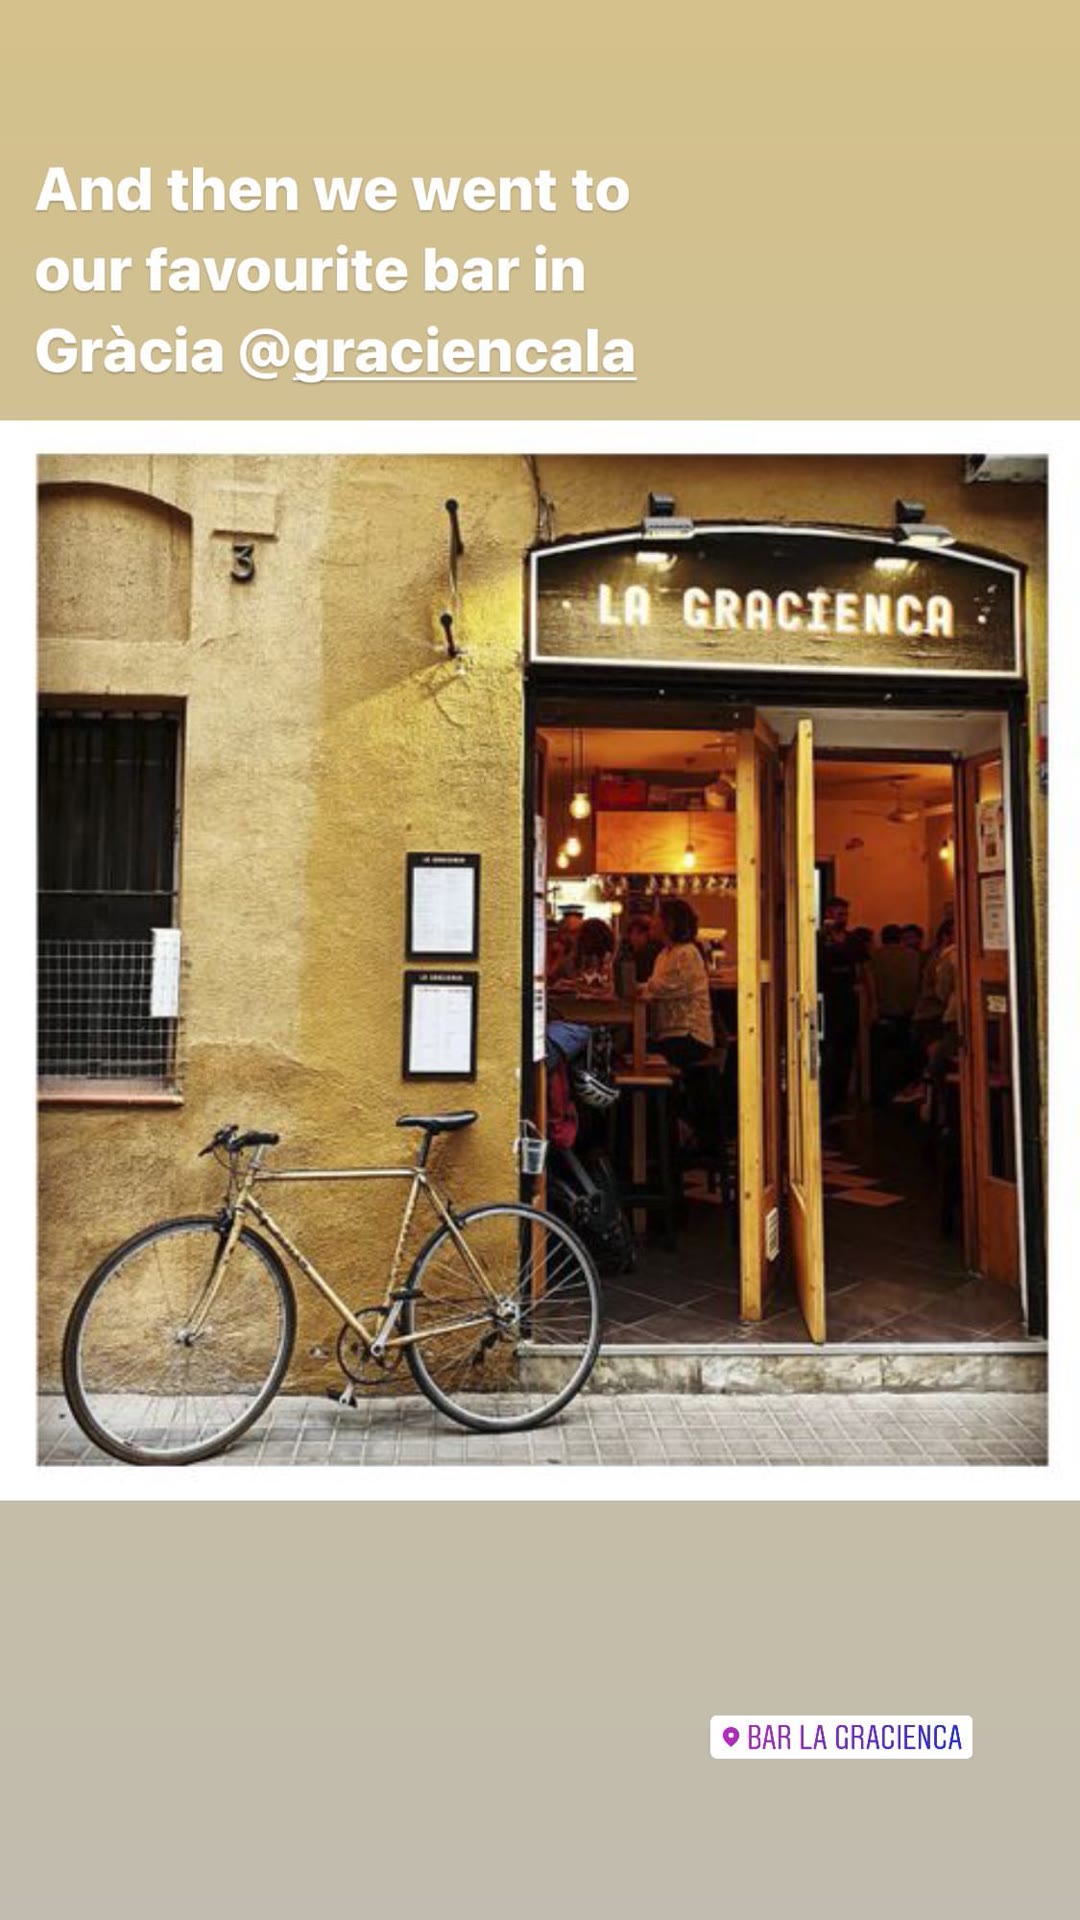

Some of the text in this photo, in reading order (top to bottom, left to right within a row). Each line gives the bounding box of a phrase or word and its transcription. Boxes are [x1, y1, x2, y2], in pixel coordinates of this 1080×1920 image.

[230, 545, 255, 584] 3
[598, 583, 954, 638] LA GRACIENCA
